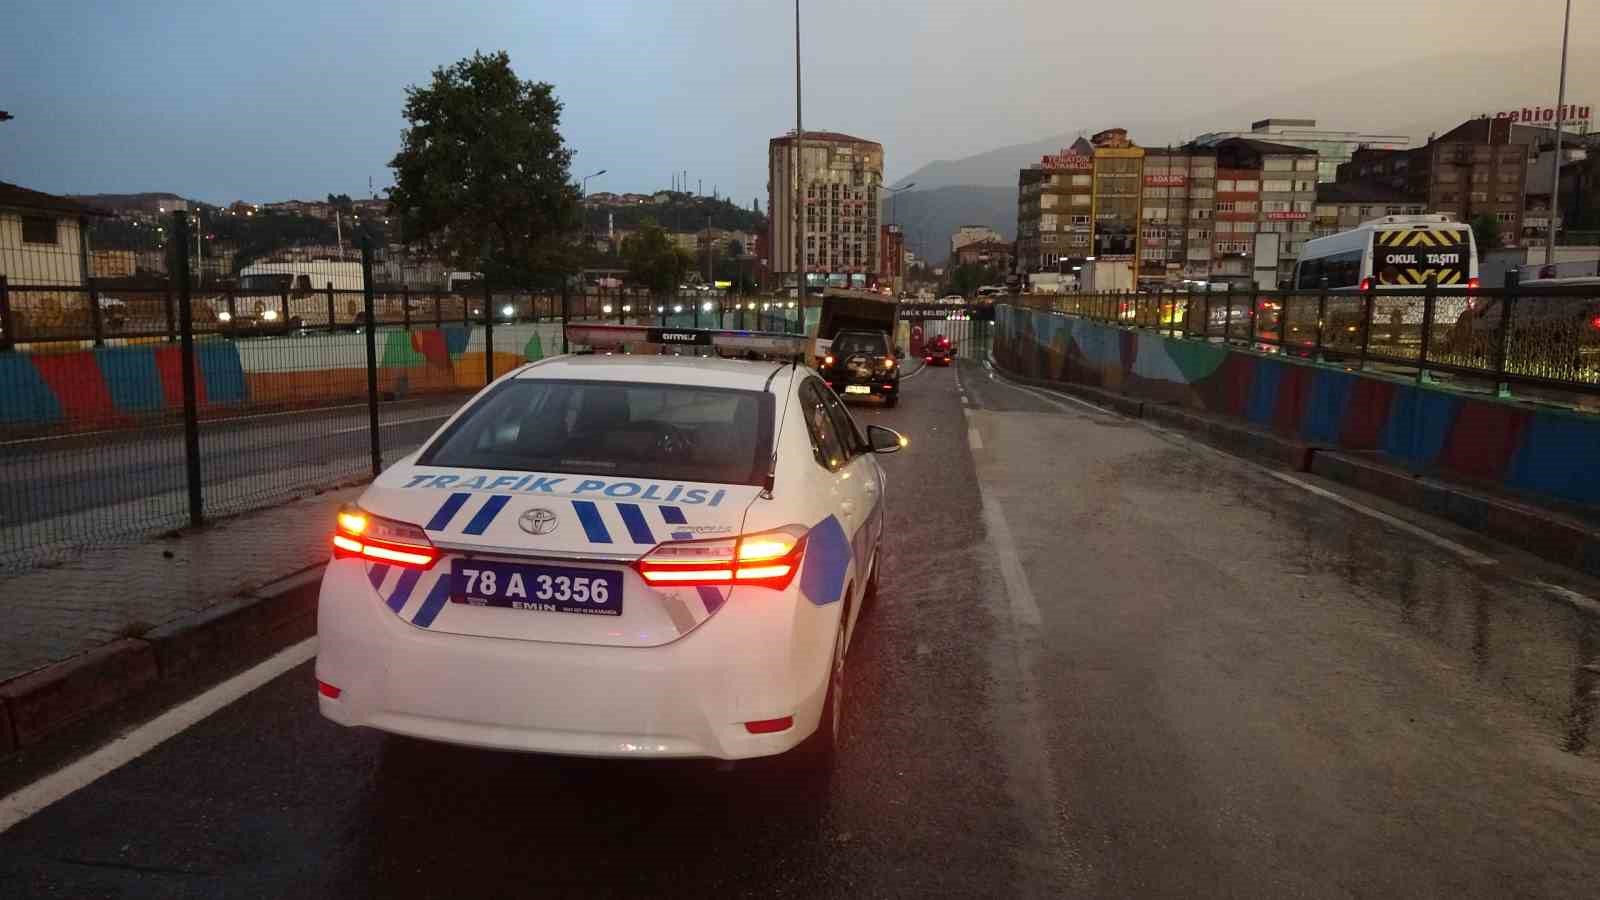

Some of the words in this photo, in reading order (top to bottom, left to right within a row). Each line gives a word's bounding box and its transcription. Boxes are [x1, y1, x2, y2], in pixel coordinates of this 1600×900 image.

[1386, 254, 1418, 264] OKUL
[401, 473, 566, 494] TRAFİK
[462, 569, 497, 595] 78
[505, 573, 527, 598] A
[536, 574, 609, 603] 3356
